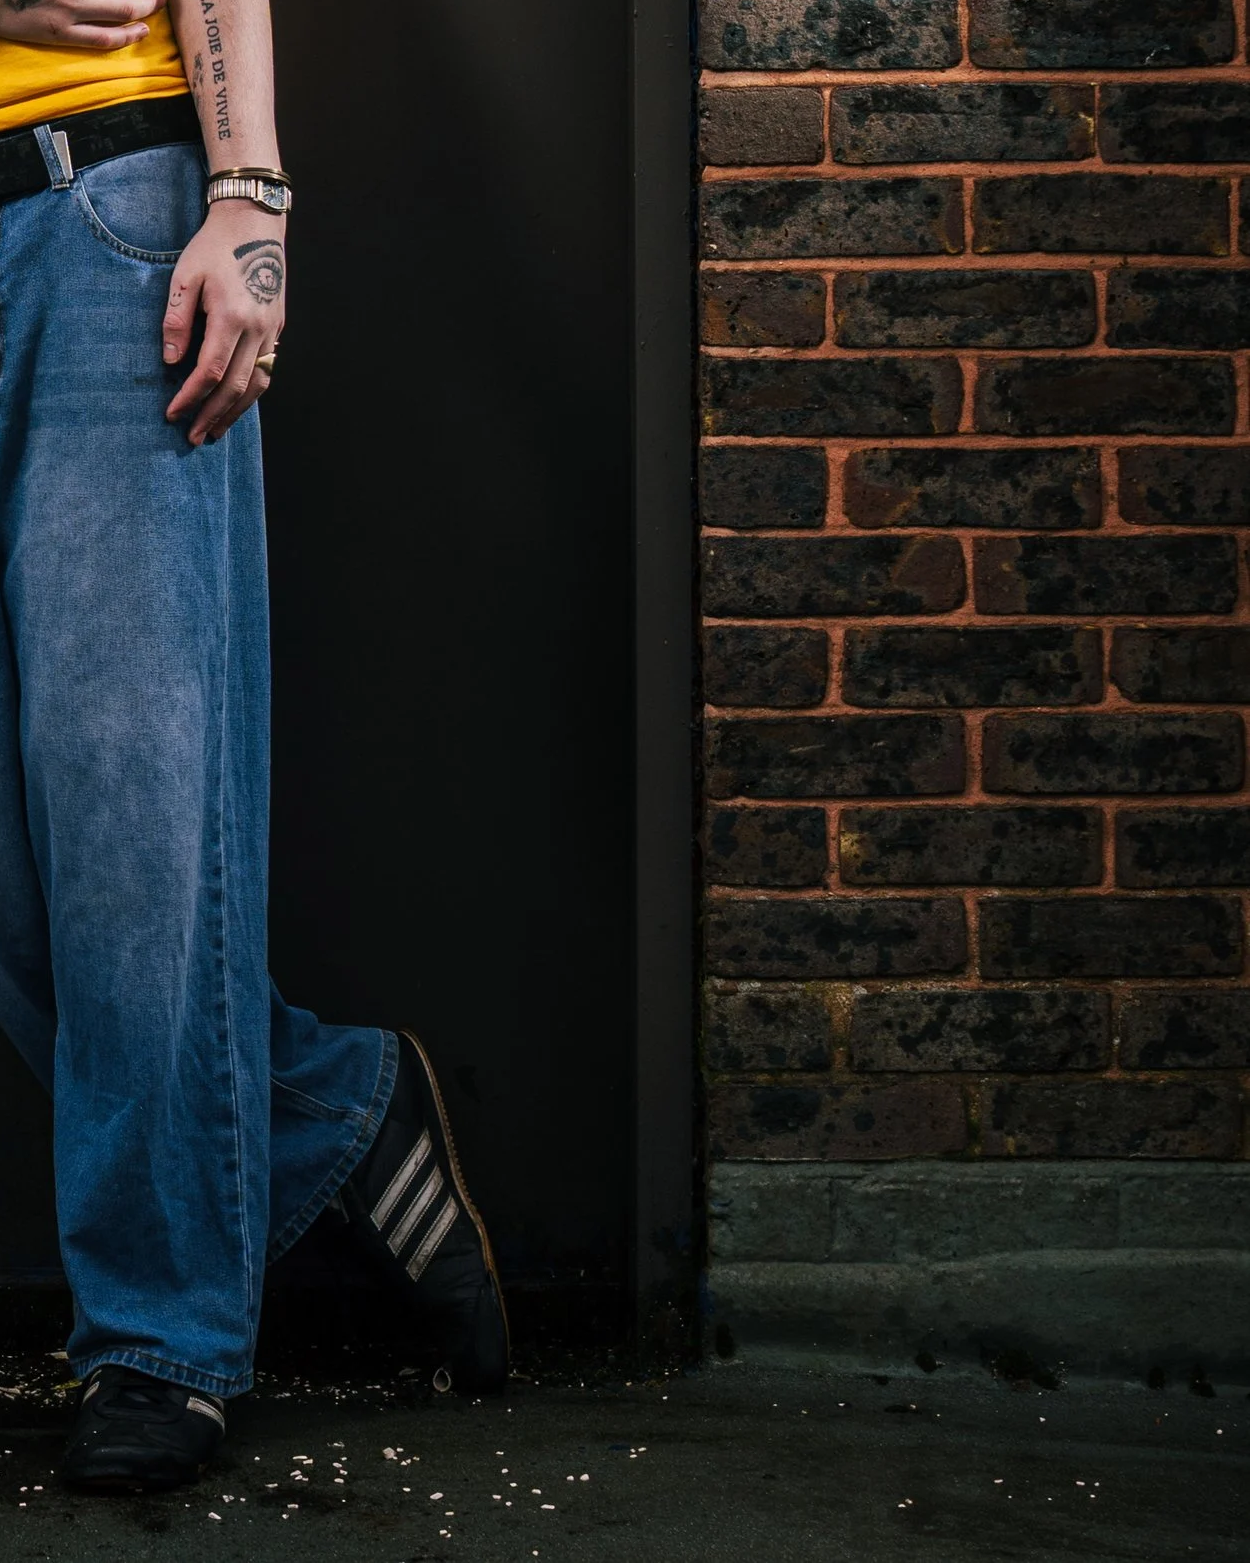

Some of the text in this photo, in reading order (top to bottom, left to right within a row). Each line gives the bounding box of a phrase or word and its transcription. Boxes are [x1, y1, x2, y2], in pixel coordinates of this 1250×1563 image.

[205, 18, 223, 55] JOIE
[212, 59, 226, 84] DE
[215, 87, 232, 141] VIVRE
